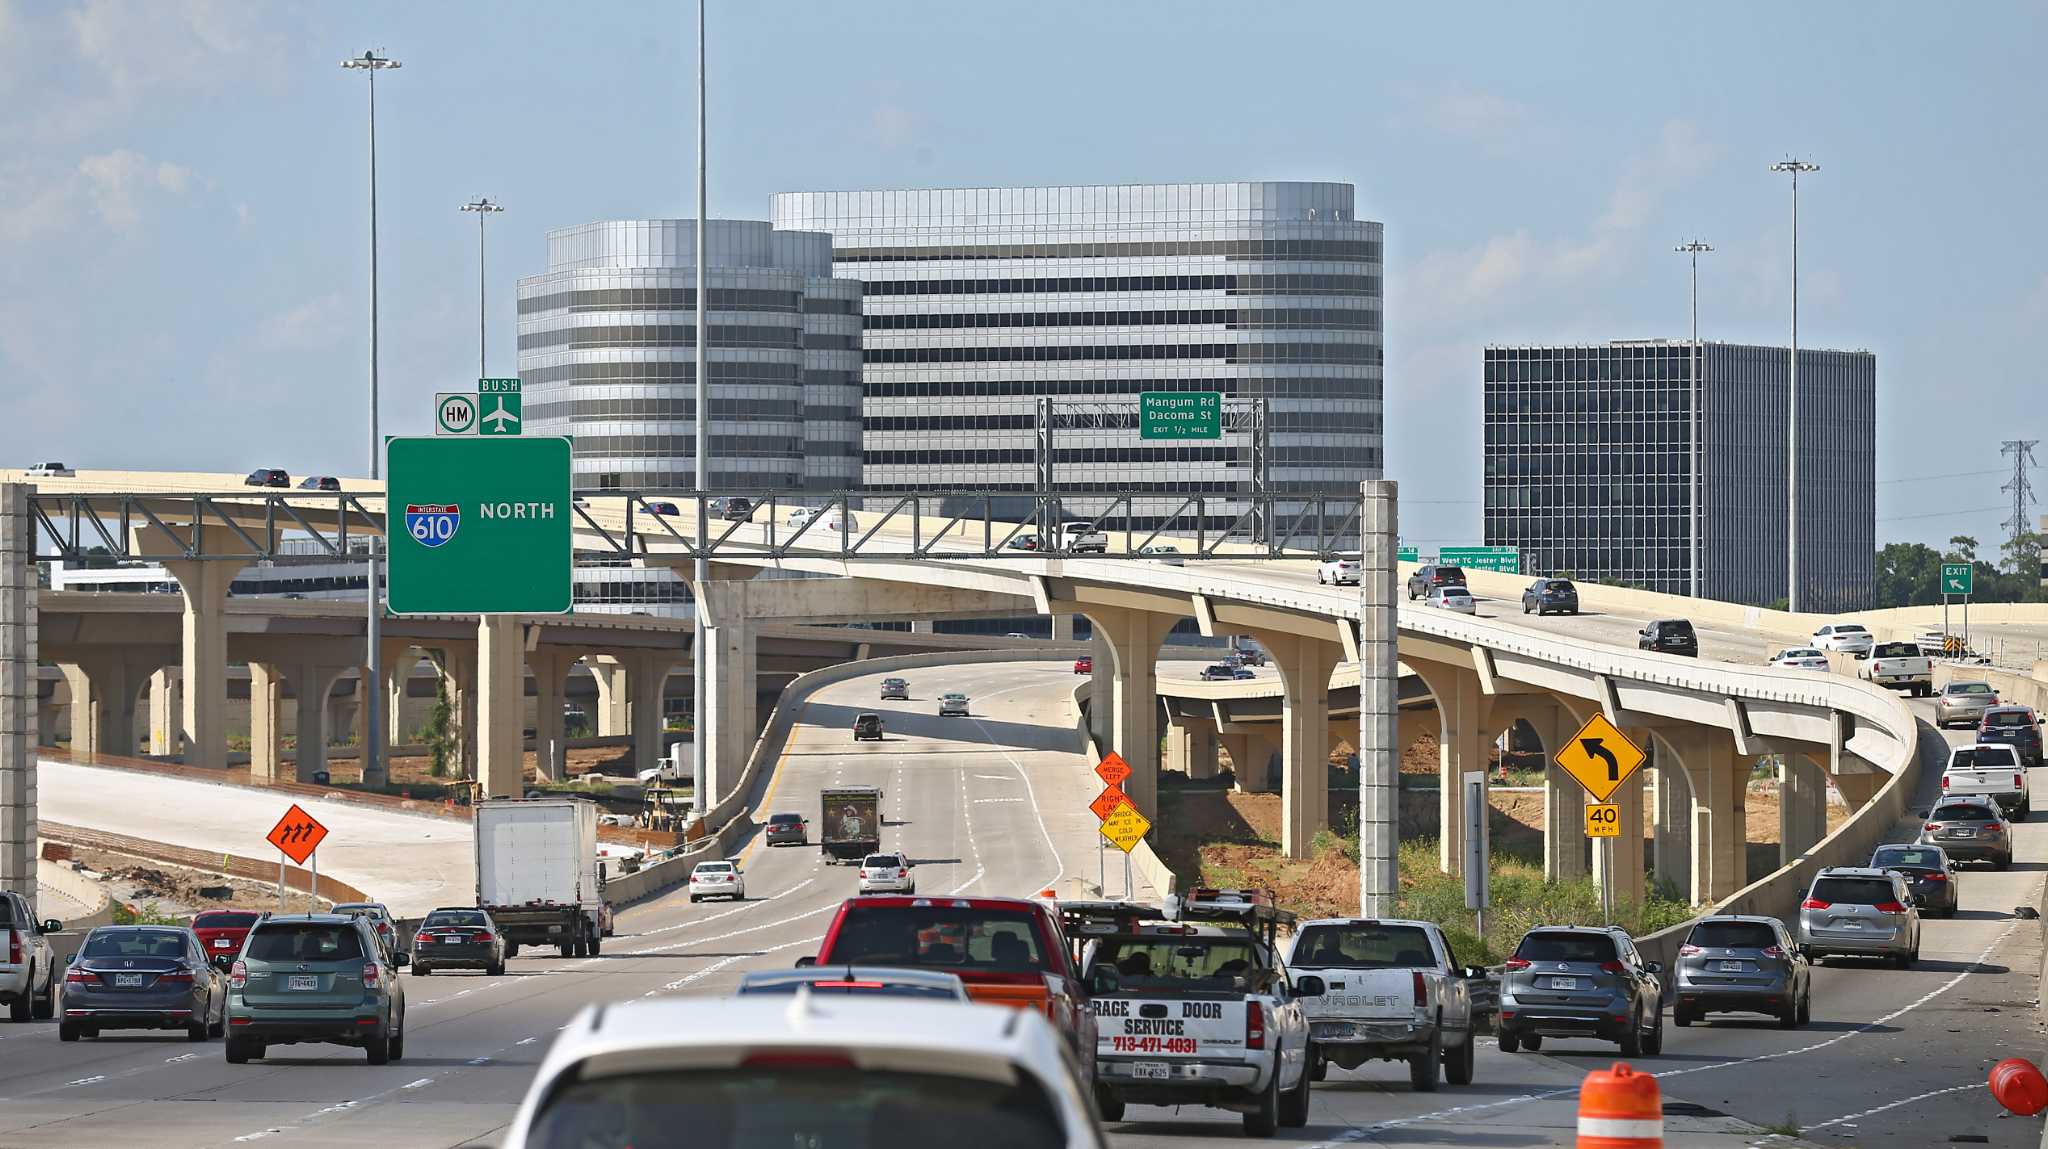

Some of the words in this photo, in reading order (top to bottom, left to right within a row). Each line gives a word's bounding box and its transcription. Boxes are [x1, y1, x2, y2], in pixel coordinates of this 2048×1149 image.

[482, 380, 518, 391] BUSH
[1146, 397, 1194, 408] Mangum
[1200, 397, 1215, 407] Rd
[446, 406, 468, 422] HM
[1149, 410, 1195, 420] Dacoma
[1200, 410, 1212, 420] St
[480, 503, 554, 519] NORTH
[413, 516, 453, 539] 610
[1945, 567, 1968, 576] EXIT
[1590, 808, 1617, 823] 40
[1320, 995, 1399, 1007] VROLET
[1091, 1000, 1130, 1017] RAGE
[1182, 1002, 1222, 1019] DOOR
[1124, 1019, 1184, 1036] SERVICE
[1113, 1036, 1197, 1053] 713-471-4031
